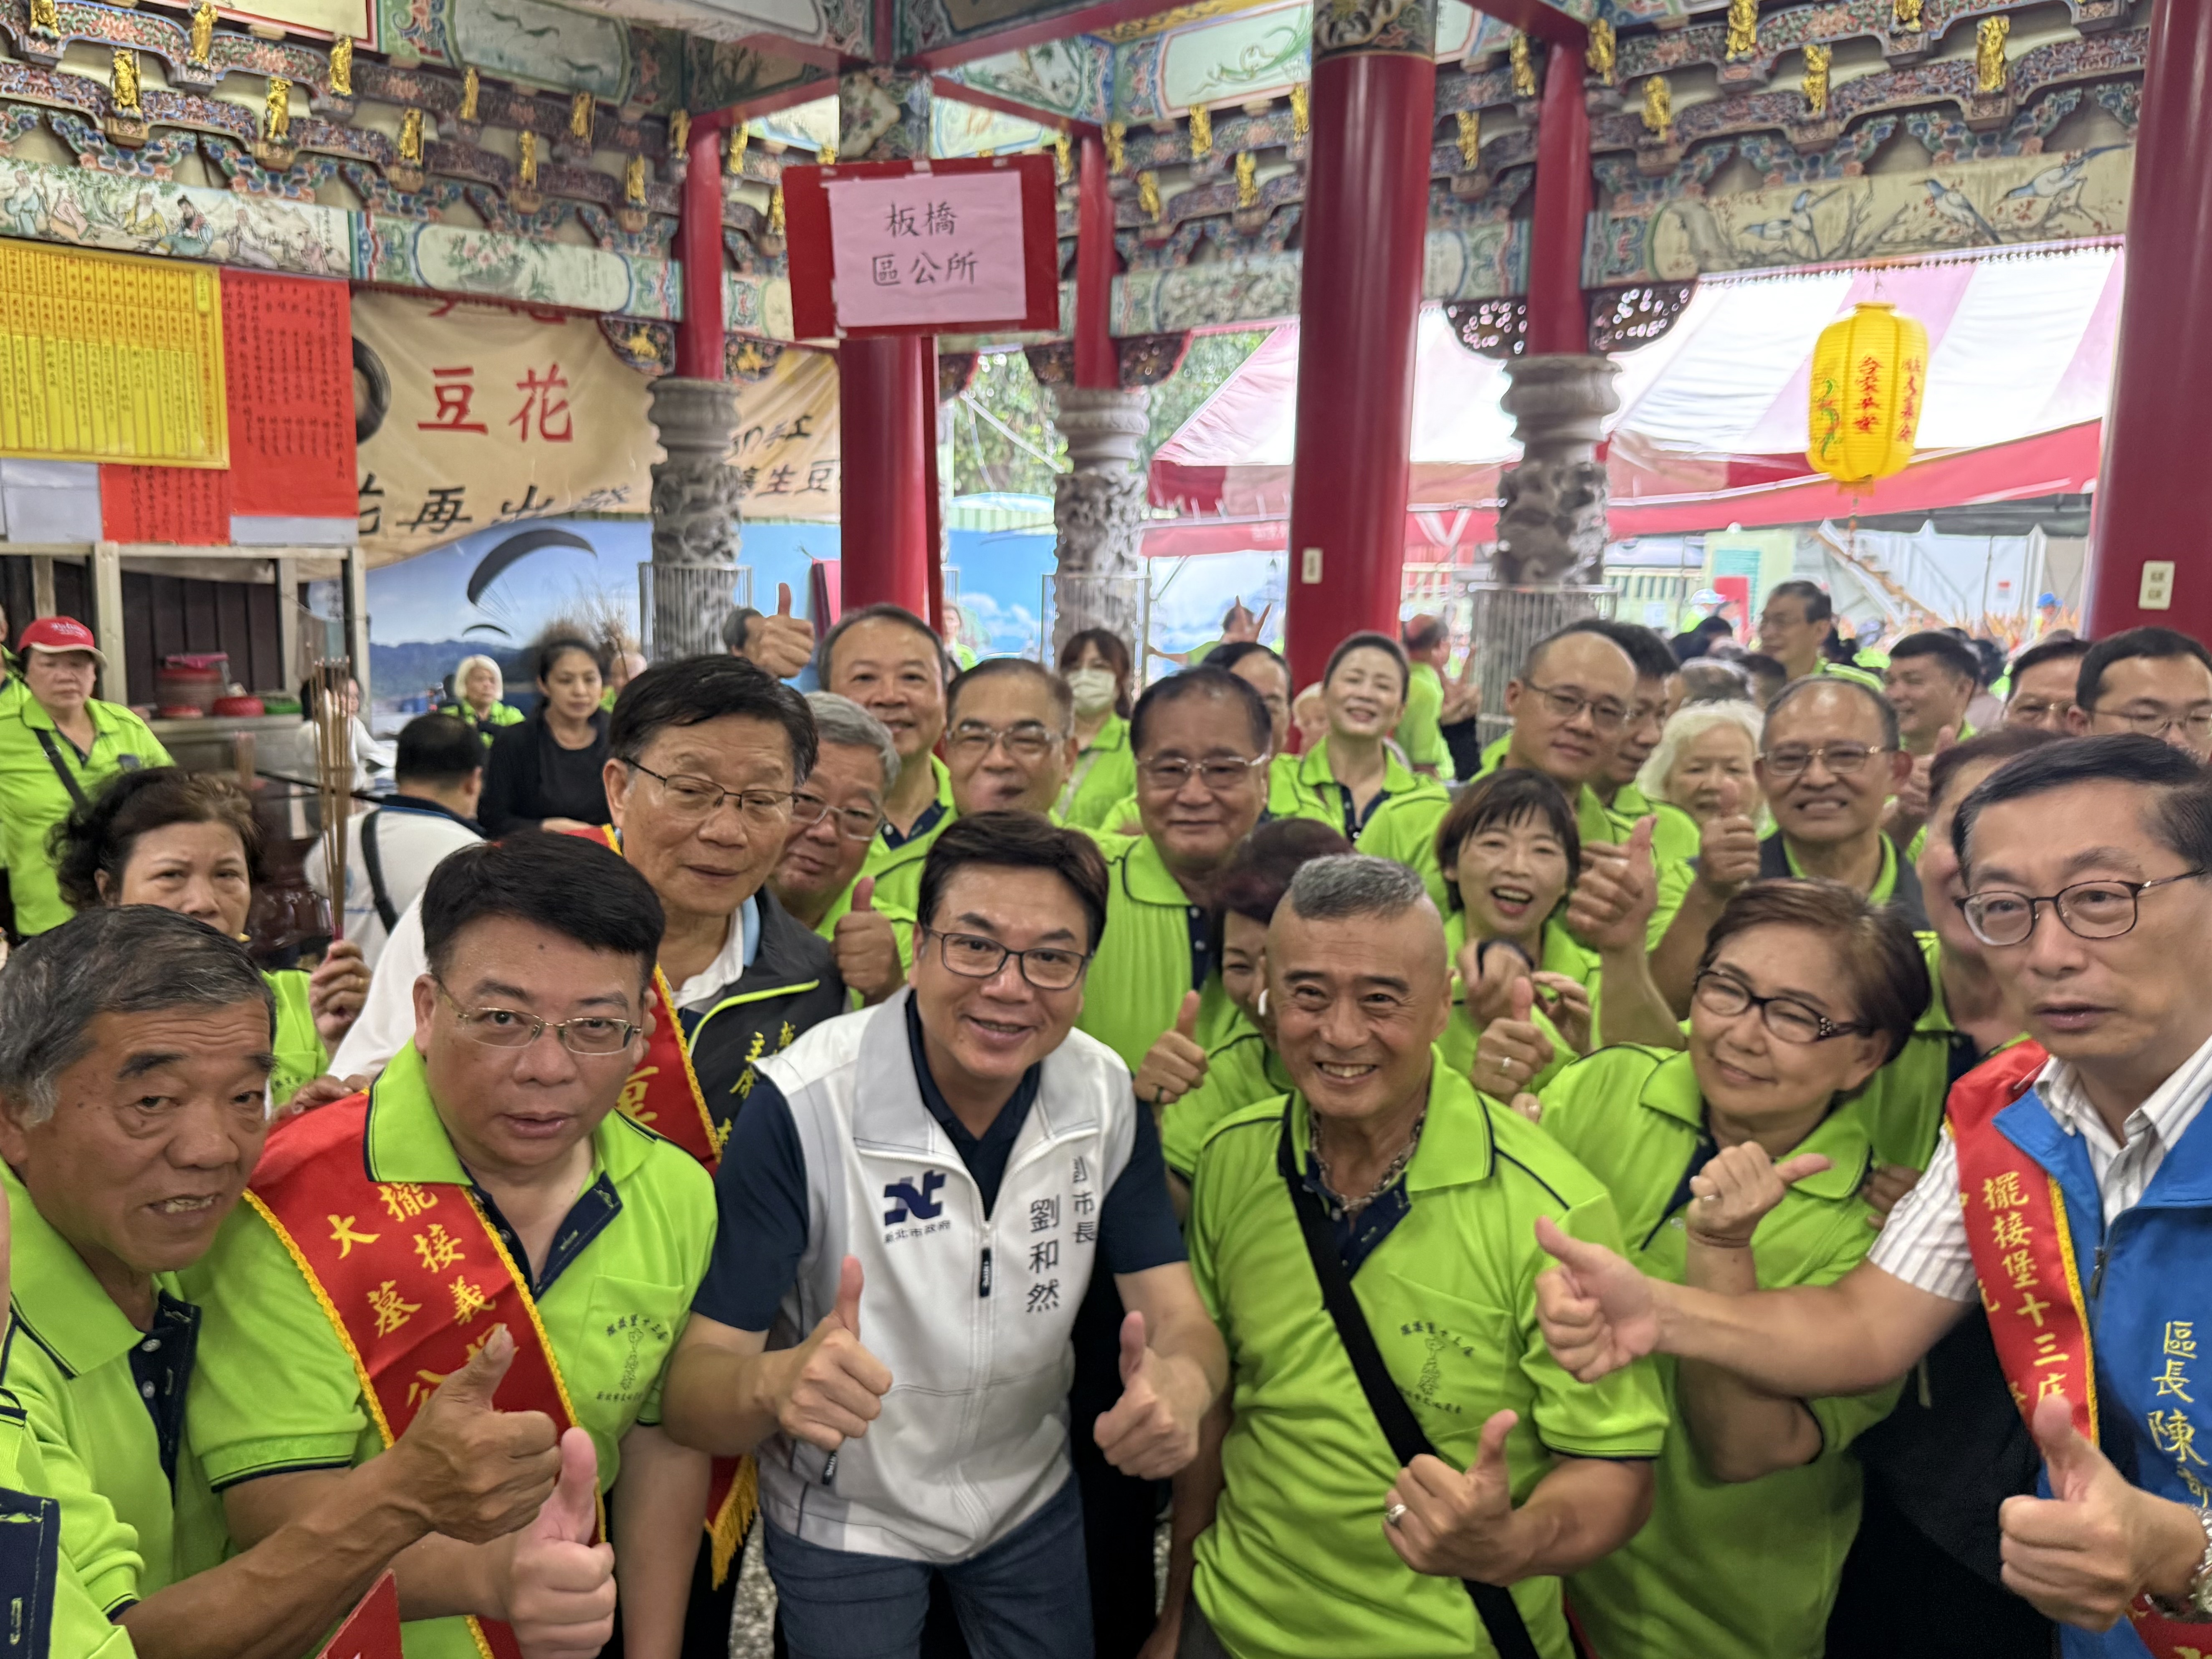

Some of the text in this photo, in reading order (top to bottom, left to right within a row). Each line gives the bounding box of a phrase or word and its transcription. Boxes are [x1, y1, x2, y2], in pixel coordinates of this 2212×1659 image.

[886, 200, 957, 238] 板橋
[872, 250, 979, 286] 區公所
[418, 362, 573, 443] 豆花
[1027, 1194, 1061, 1313] 劉和然
